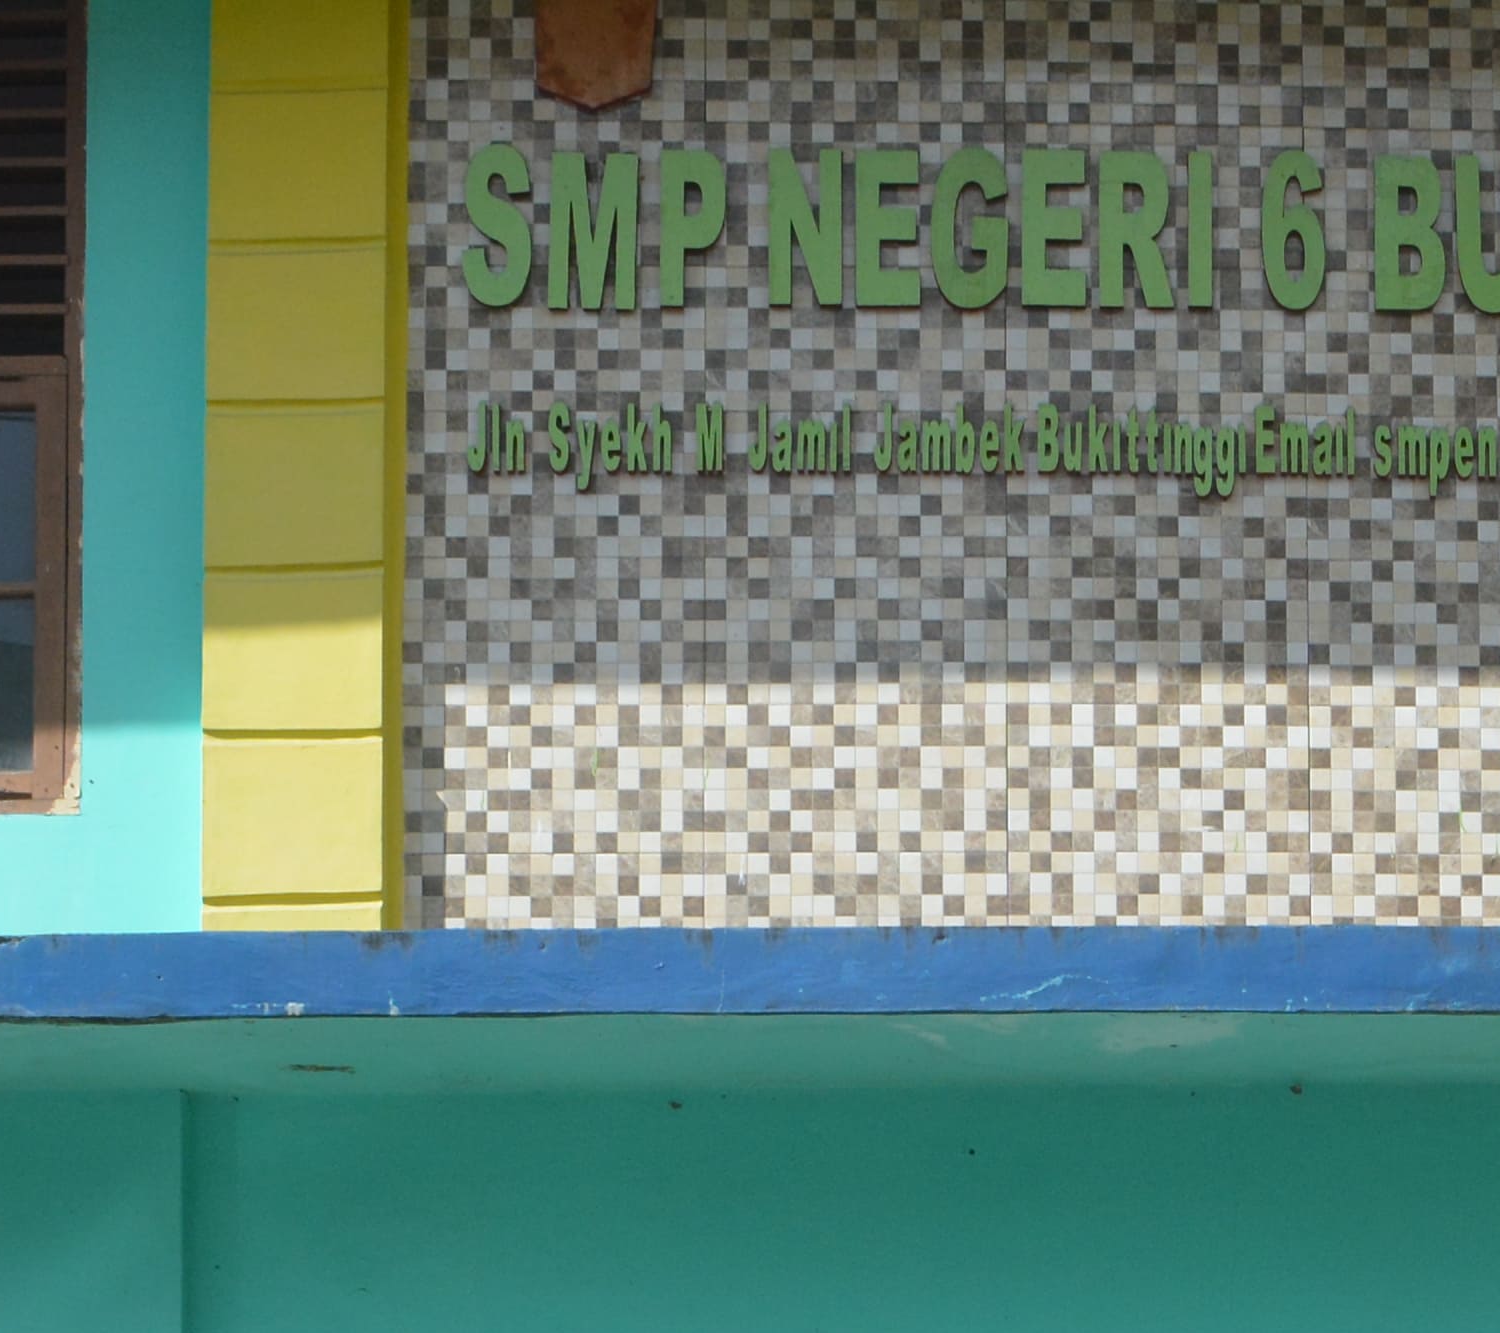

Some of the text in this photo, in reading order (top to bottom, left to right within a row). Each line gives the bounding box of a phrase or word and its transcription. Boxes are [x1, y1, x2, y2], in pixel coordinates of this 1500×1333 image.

[461, 142, 727, 312] SMP
[767, 147, 1214, 311] NEGERI
[1261, 149, 1327, 312] 6
[547, 402, 673, 491] Syekh
[696, 402, 724, 473] M
[747, 402, 851, 473] Jamil
[874, 401, 1024, 474] Jambek
[1037, 403, 1247, 498] Bukittinggi
[1254, 404, 1356, 477] Email
